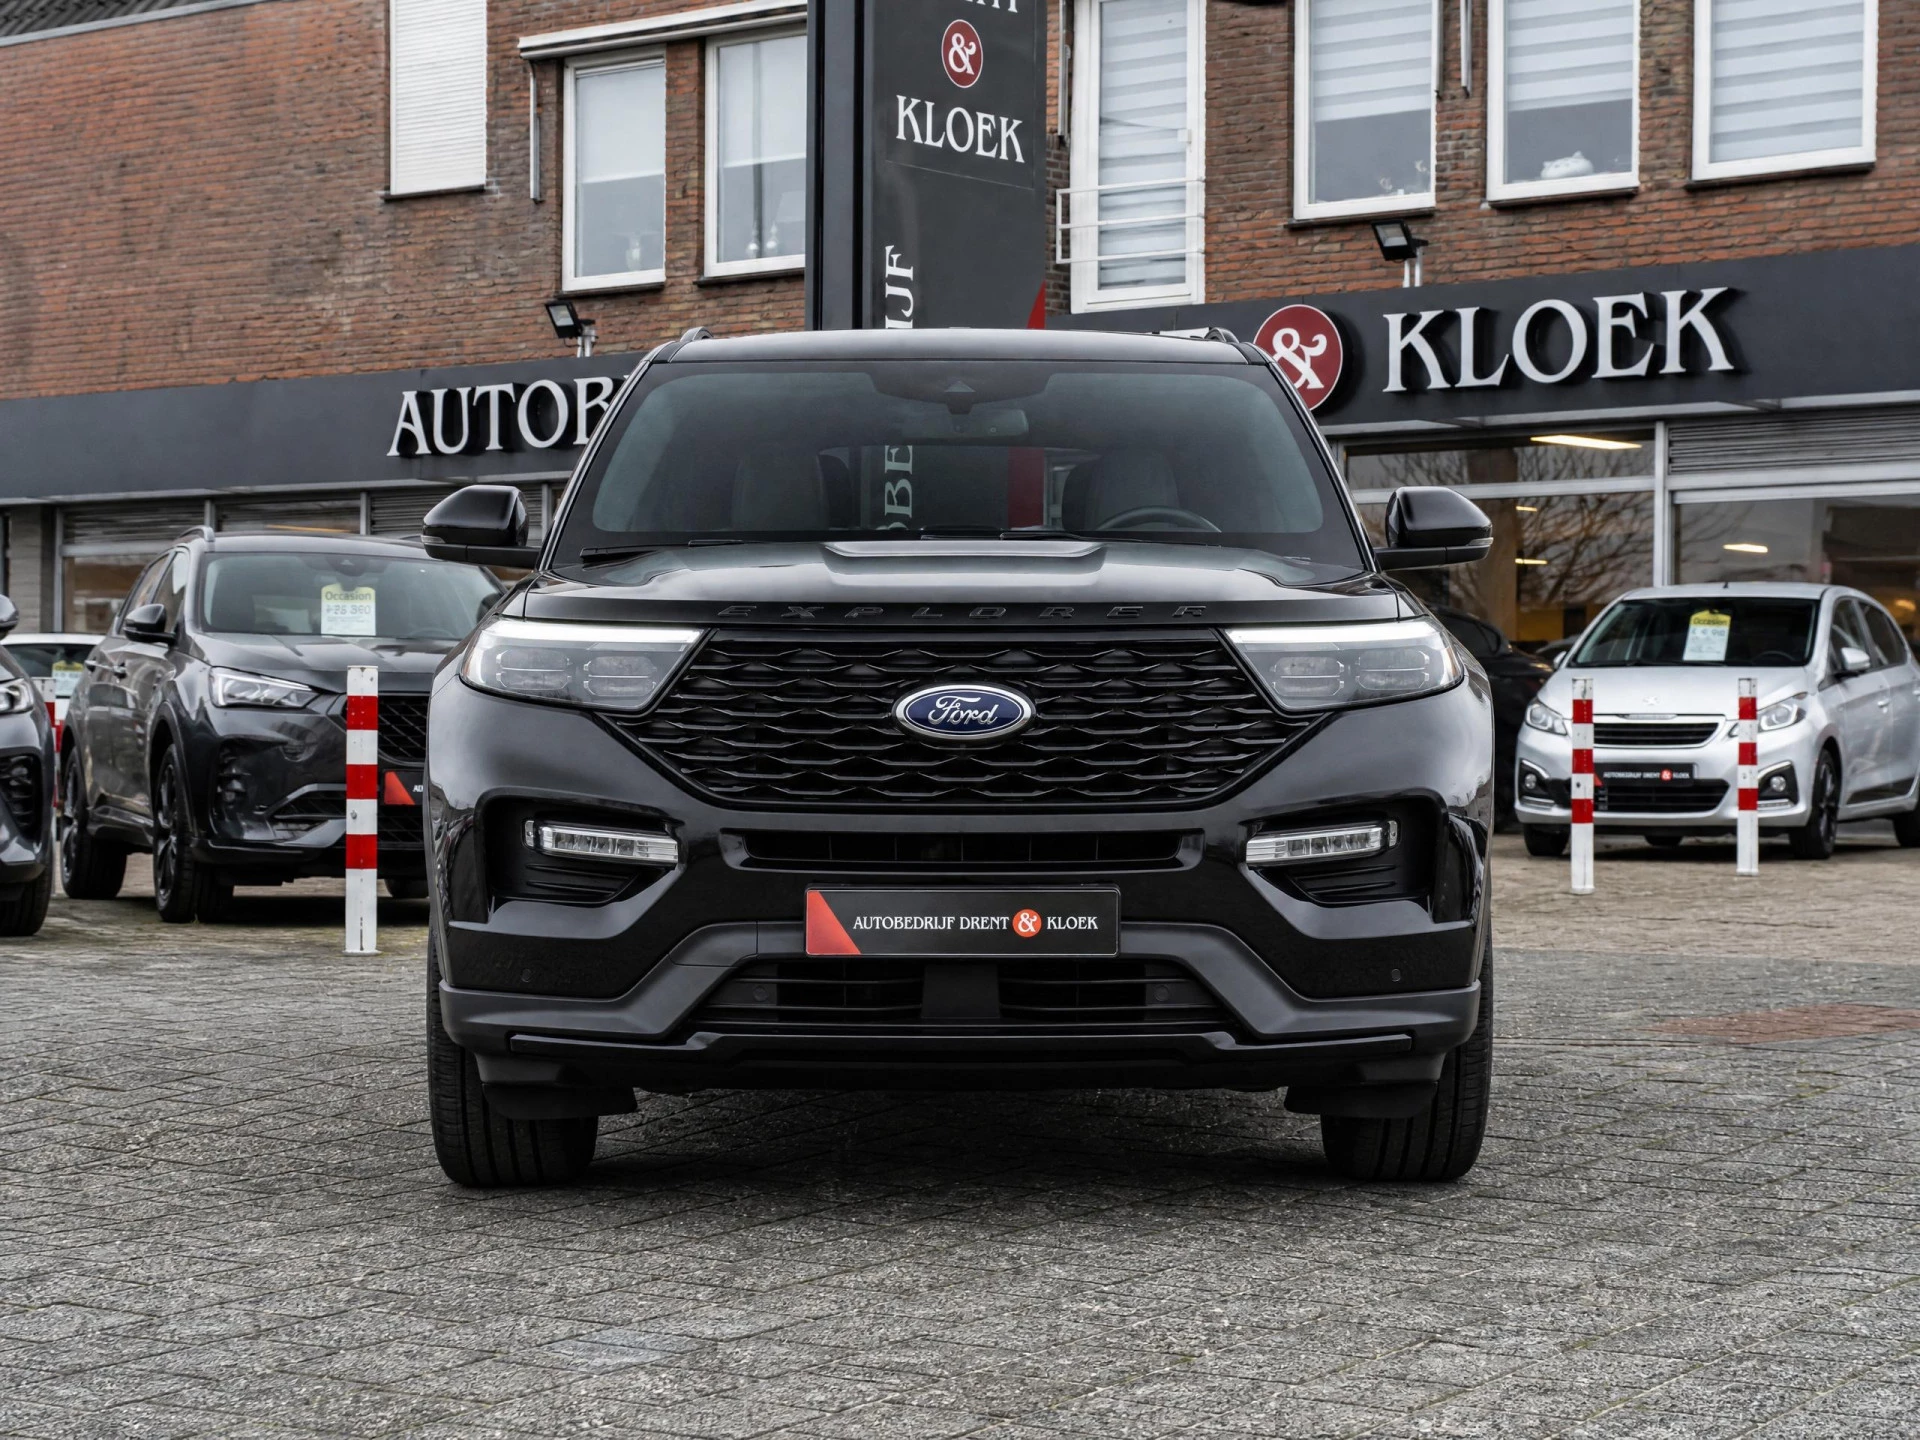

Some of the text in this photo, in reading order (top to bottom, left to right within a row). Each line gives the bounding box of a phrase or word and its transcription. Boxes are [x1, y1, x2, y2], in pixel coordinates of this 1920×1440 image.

[948, 32, 976, 75] &
[895, 94, 1025, 163] KLOEK
[1382, 287, 1735, 392] KLOEK
[386, 374, 630, 457] AUTOB
[884, 445, 913, 530] BE
[325, 591, 372, 600] Occasion
[717, 605, 1208, 618] EXPLORER
[927, 695, 998, 726] Ford
[853, 912, 1099, 933] AUTOBEDRIJF DRENT & KLOEK
